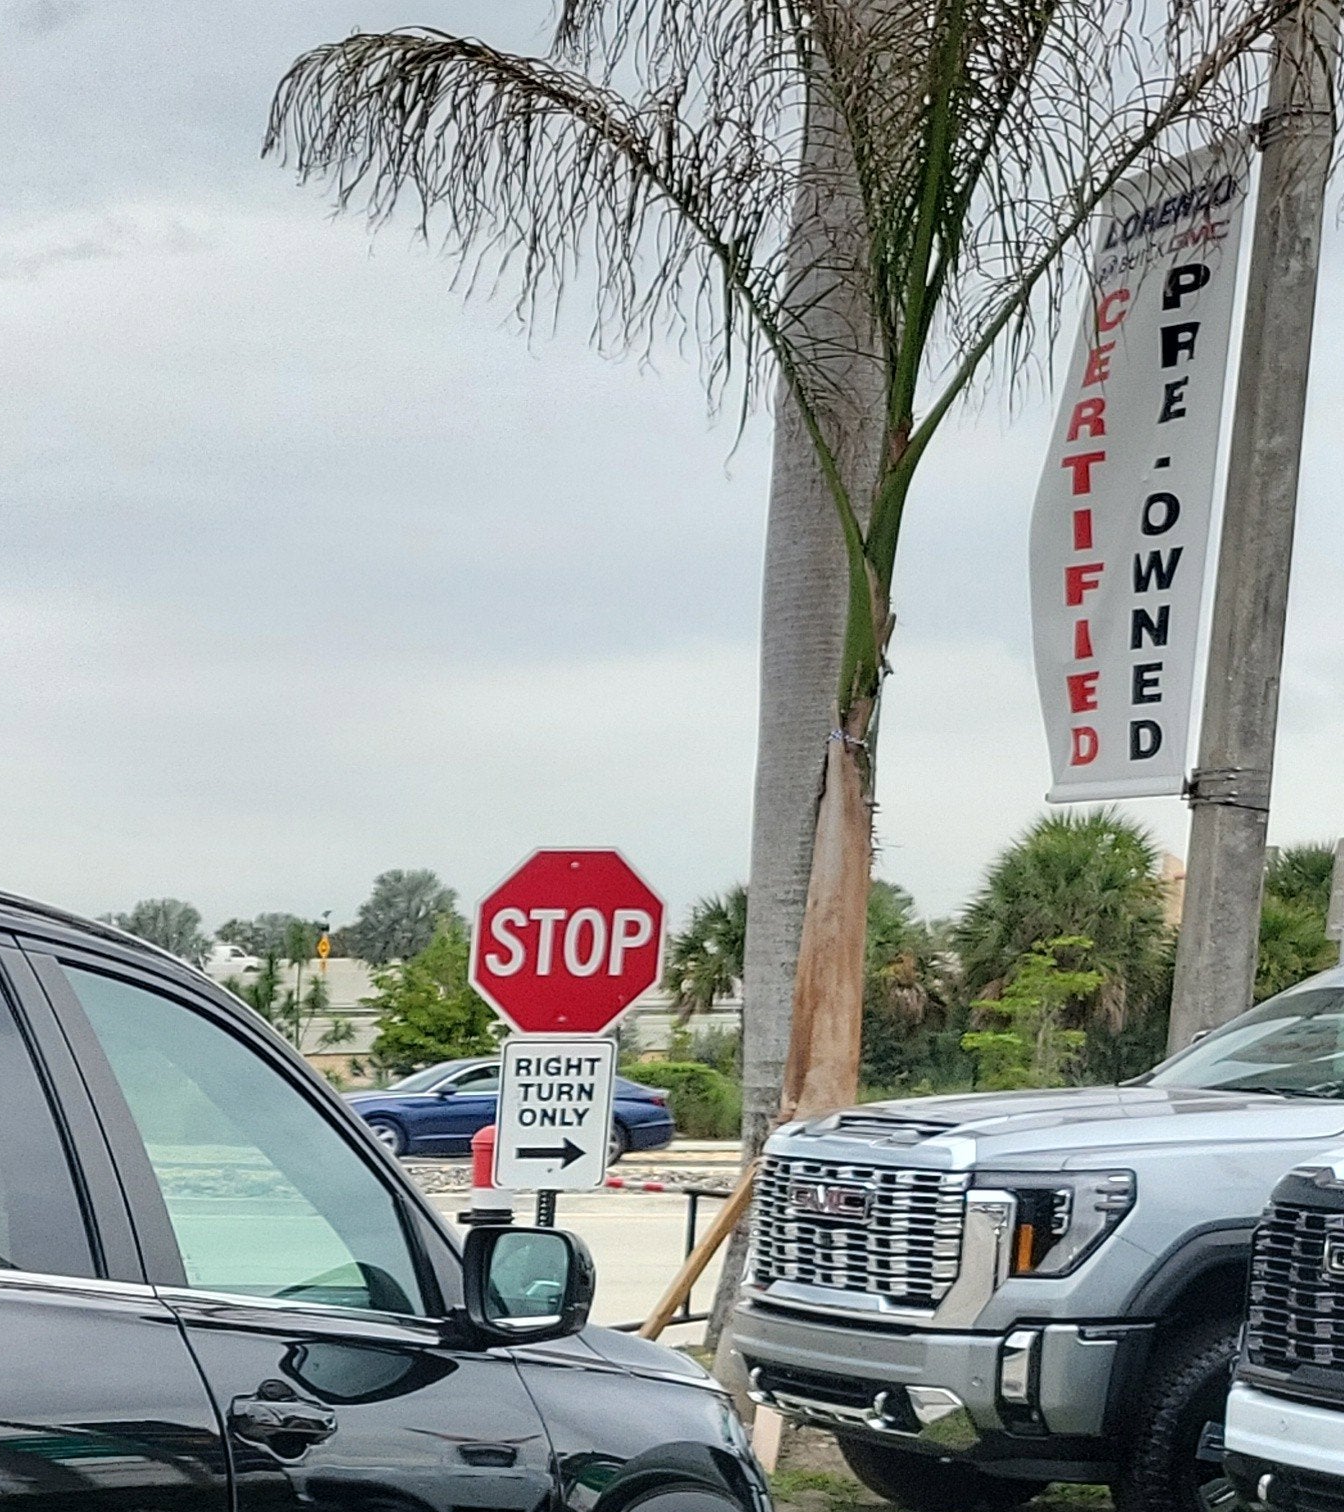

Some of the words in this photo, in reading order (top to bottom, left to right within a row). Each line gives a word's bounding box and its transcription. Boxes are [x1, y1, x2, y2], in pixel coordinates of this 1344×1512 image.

[1104, 174, 1236, 249] LORENZO
[1060, 288, 1131, 766] CERTIFIED
[484, 907, 654, 978] STOP
[515, 1057, 602, 1077] RIGHT
[518, 1082, 595, 1102] TURN
[518, 1107, 589, 1127] ONLY
